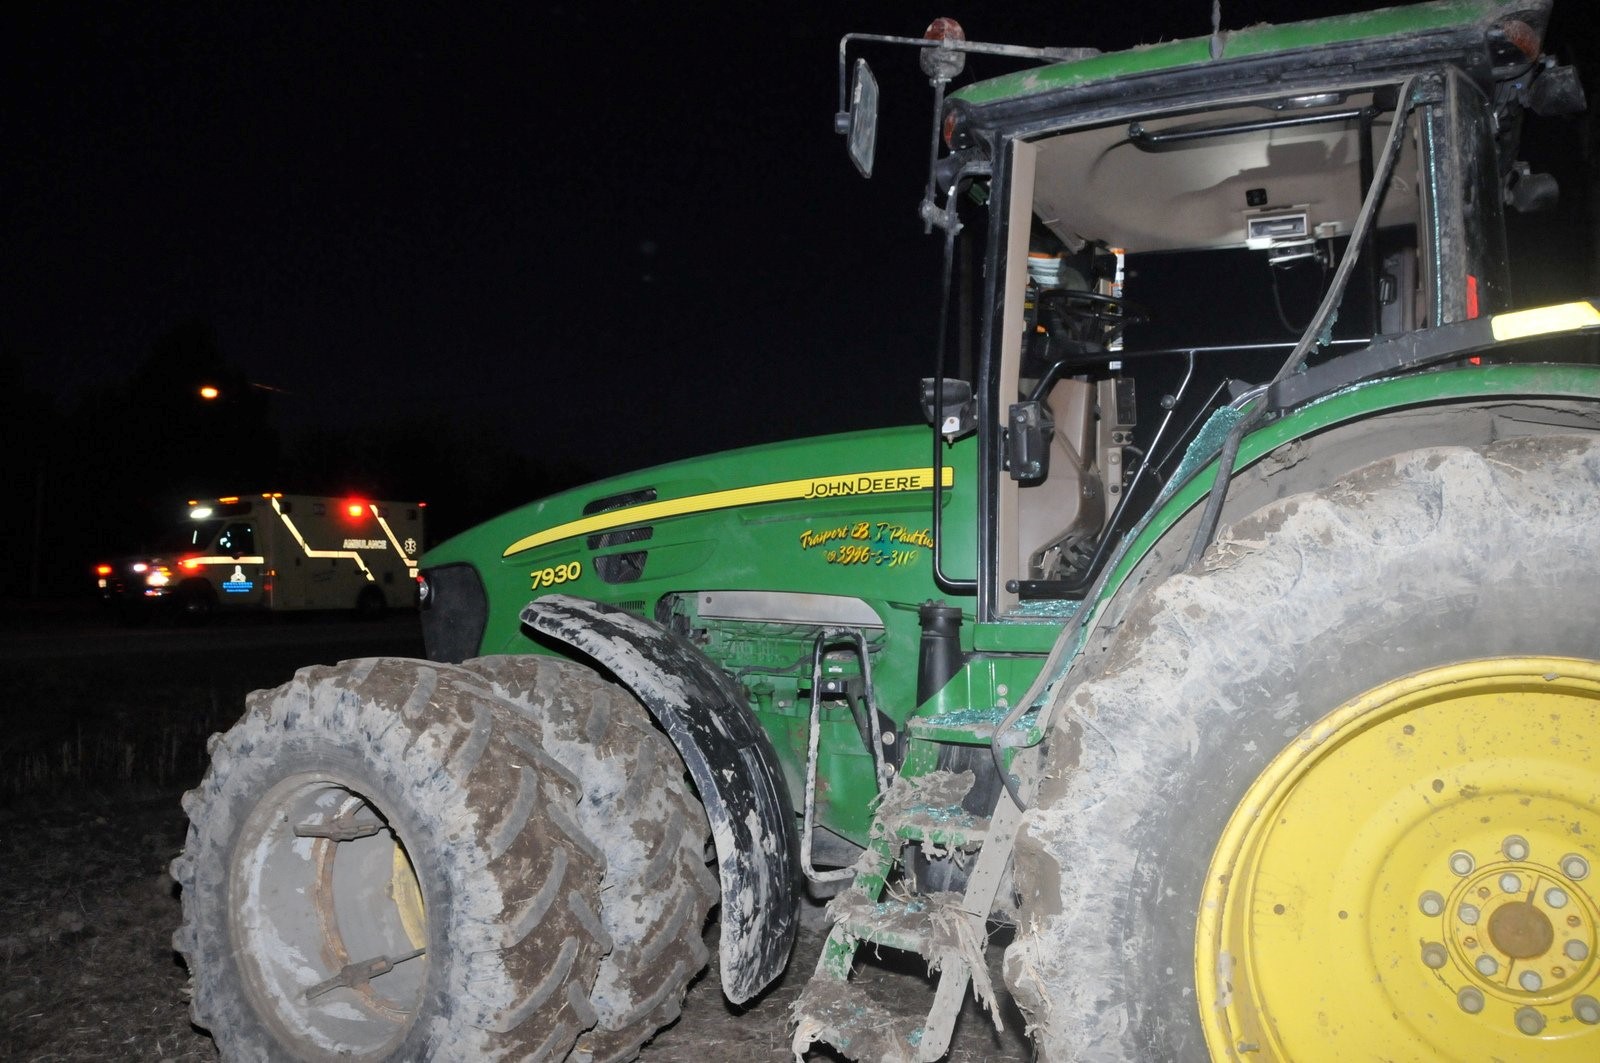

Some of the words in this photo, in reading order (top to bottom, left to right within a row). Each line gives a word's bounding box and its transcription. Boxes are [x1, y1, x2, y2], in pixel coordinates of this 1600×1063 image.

[805, 481, 853, 497] JOHN
[857, 475, 921, 492] DEERE
[343, 539, 387, 550] AMBULANCE
[530, 561, 581, 590] 7930
